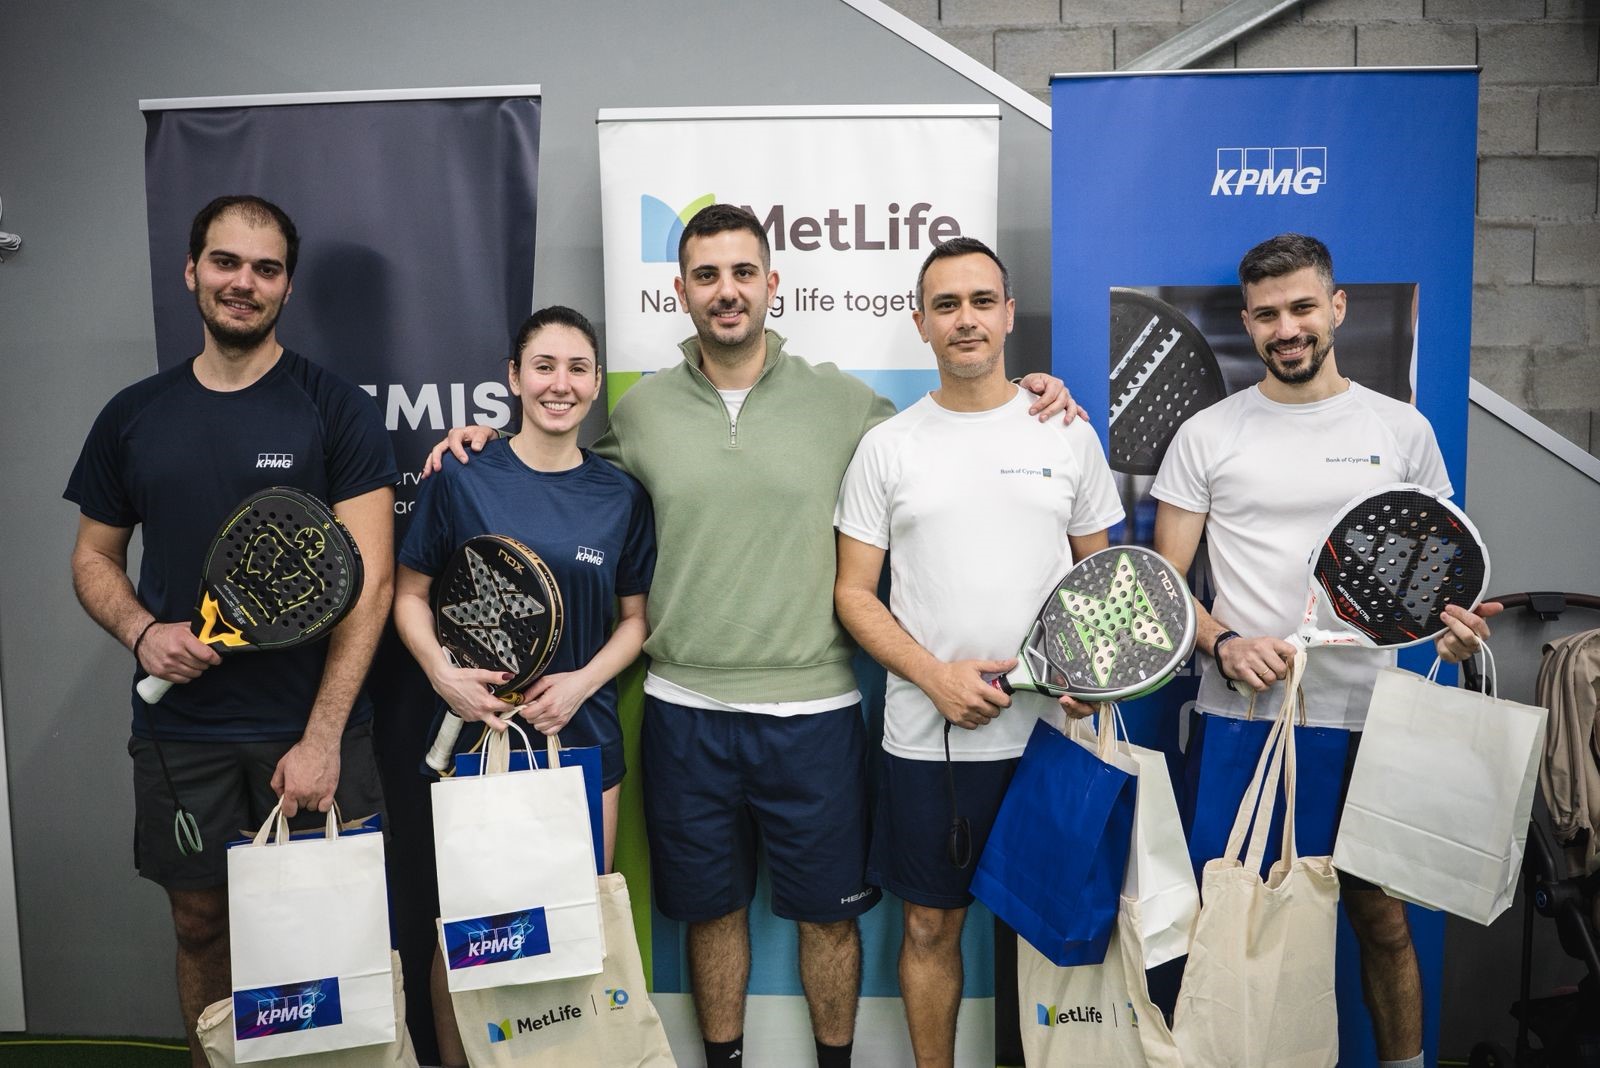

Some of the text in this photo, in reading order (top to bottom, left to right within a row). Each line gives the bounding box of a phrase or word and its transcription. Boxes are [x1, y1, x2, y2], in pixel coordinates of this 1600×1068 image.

[1210, 166, 1323, 196] KPMG
[795, 288, 835, 312] life
[844, 290, 916, 317] toget
[256, 458, 292, 468] KPMG
[1022, 468, 1042, 476] Cyprus
[575, 551, 603, 566] KPMG
[841, 888, 872, 904] HEAD
[468, 934, 523, 957] KPMG
[256, 1003, 315, 1026] KPMG
[517, 1004, 582, 1034] MetLife
